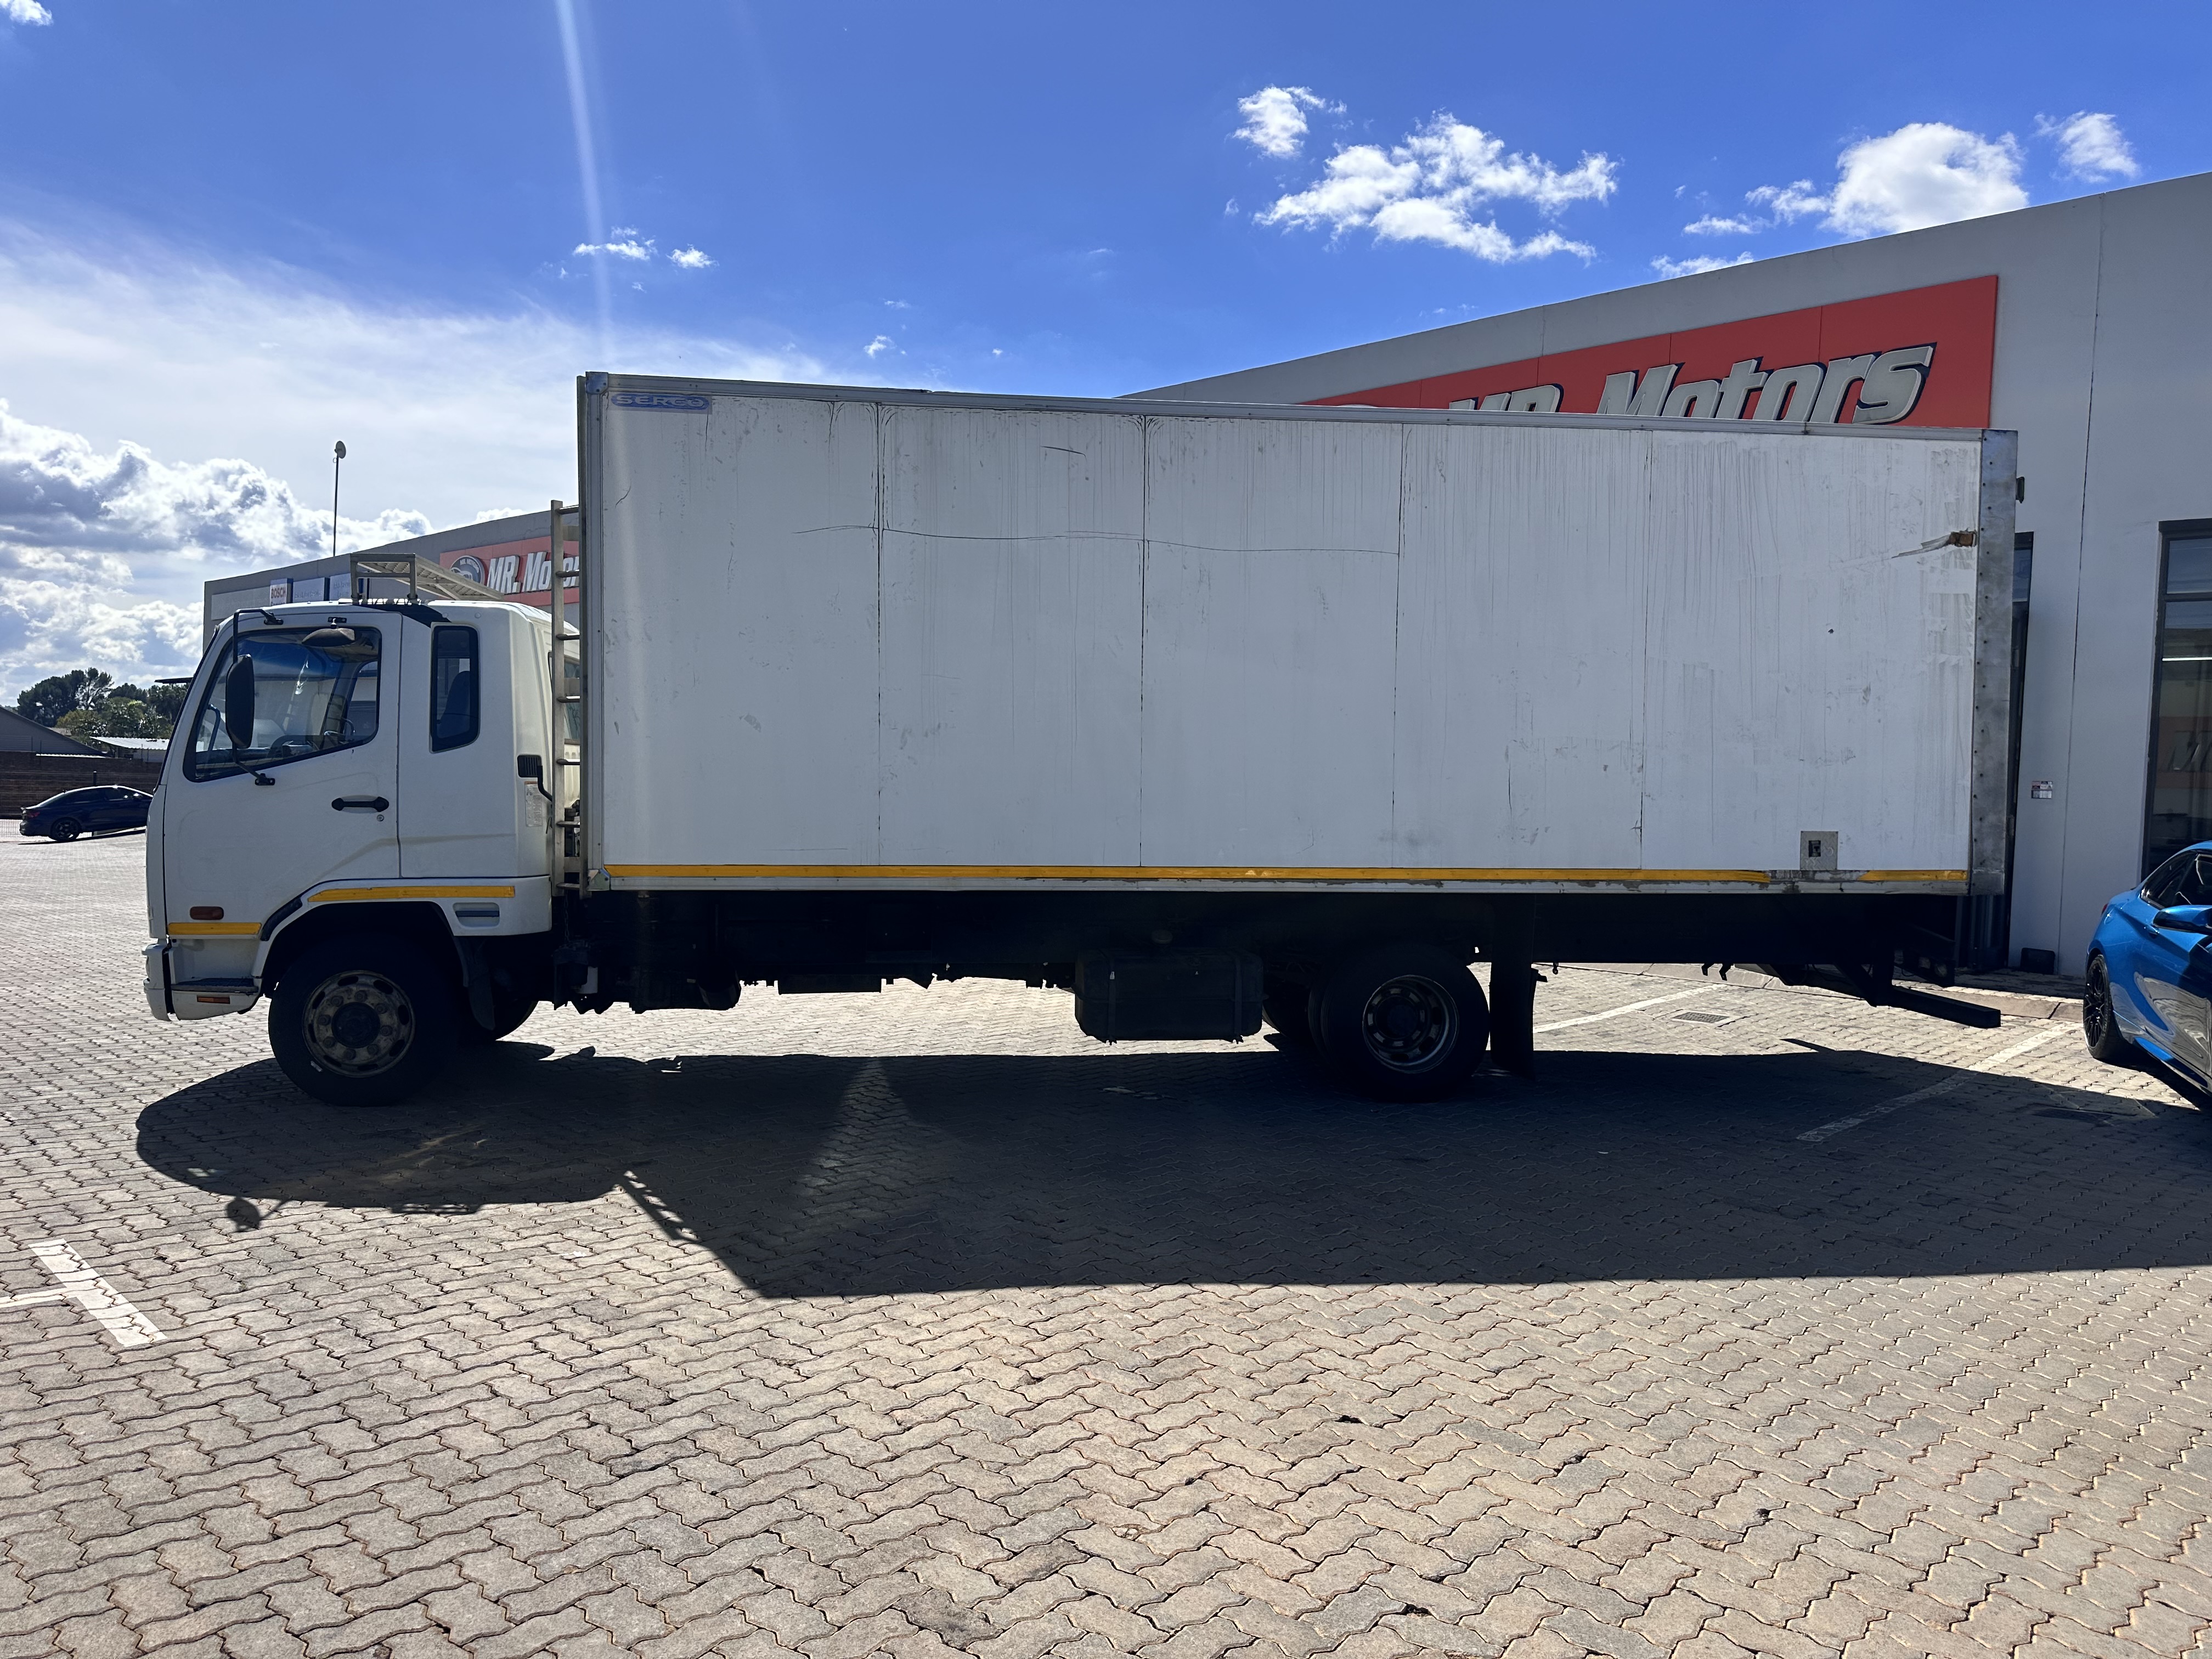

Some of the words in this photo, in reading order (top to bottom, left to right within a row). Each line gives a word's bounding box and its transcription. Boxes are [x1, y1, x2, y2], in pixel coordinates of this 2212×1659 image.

[1595, 345, 1937, 424] Motors
[616, 395, 704, 407] SERCO
[271, 586, 286, 599] BOSCH
